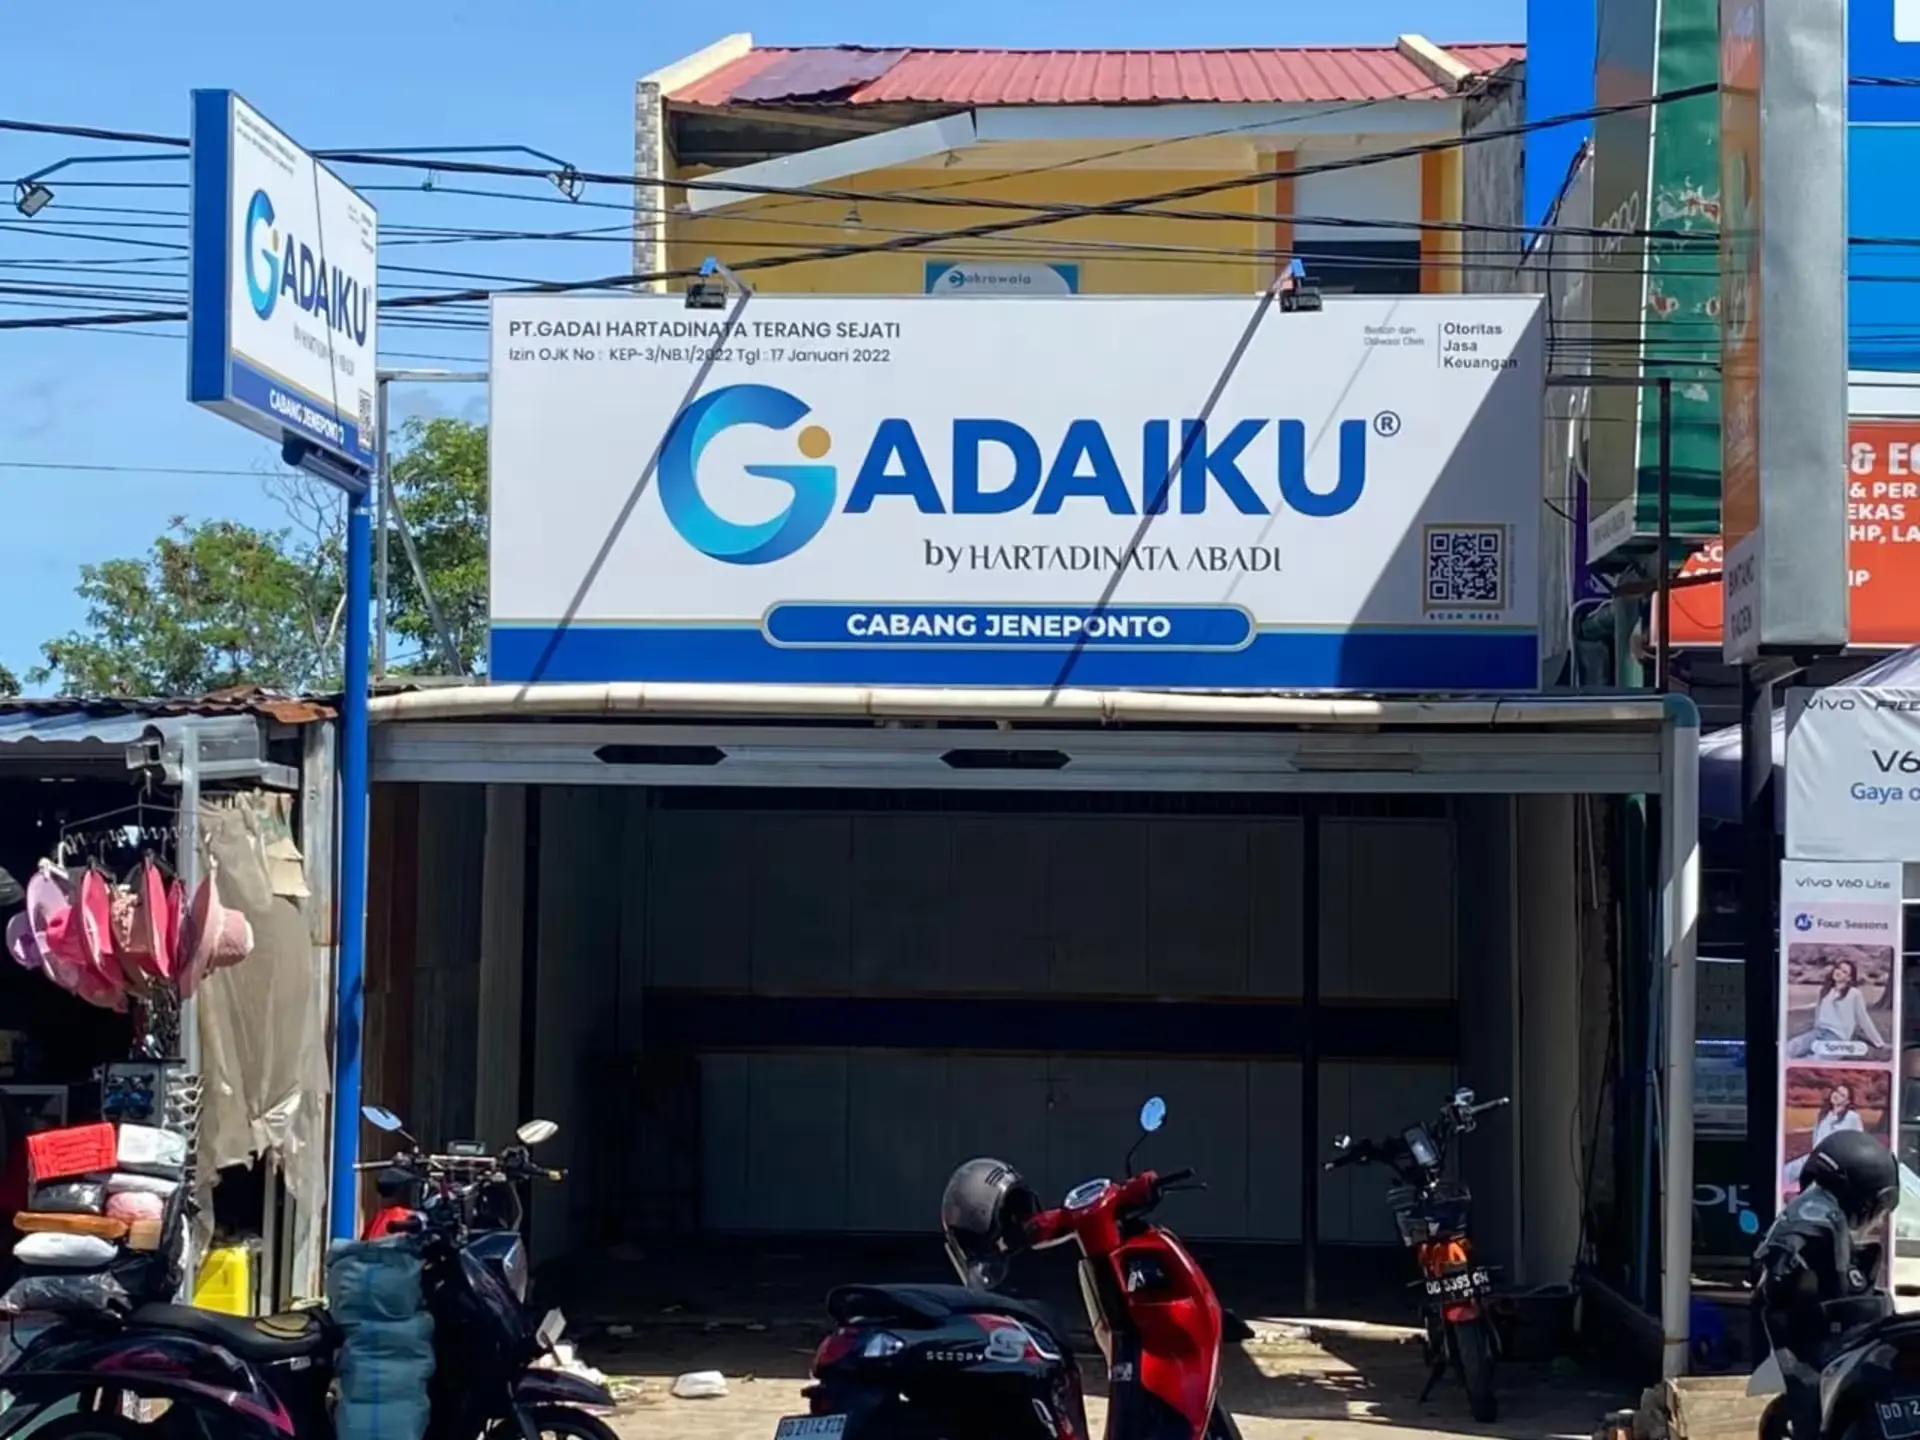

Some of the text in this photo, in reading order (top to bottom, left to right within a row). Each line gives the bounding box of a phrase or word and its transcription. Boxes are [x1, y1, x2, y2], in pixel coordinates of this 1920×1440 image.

[245, 188, 369, 347] GADAIKU
[509, 321, 900, 338] PT.GADAI HARTADINATA TERANG SEJATI
[1444, 322, 1503, 335] Otoritas
[1444, 340, 1478, 352] Jasa
[509, 348, 535, 361] Izin
[538, 348, 569, 361] OJK
[573, 348, 595, 361] No
[736, 349, 760, 366] Tgl
[787, 348, 849, 362] Januari
[852, 349, 891, 362] 2022
[1444, 356, 1518, 371] Keuangan
[1851, 442, 1877, 475] &
[657, 383, 1366, 565] GADAIKU
[1850, 481, 1918, 498] & PER
[1850, 524, 1887, 544] HP,
[924, 539, 1283, 573] by HARTADINATA ABADI
[846, 613, 1172, 638] CABANG JENEPONTO
[1803, 696, 1856, 711] vivo
[1850, 782, 1904, 805] Gaya
[1795, 877, 1833, 888] vivo
[1817, 918, 1889, 930] Four Seasons
